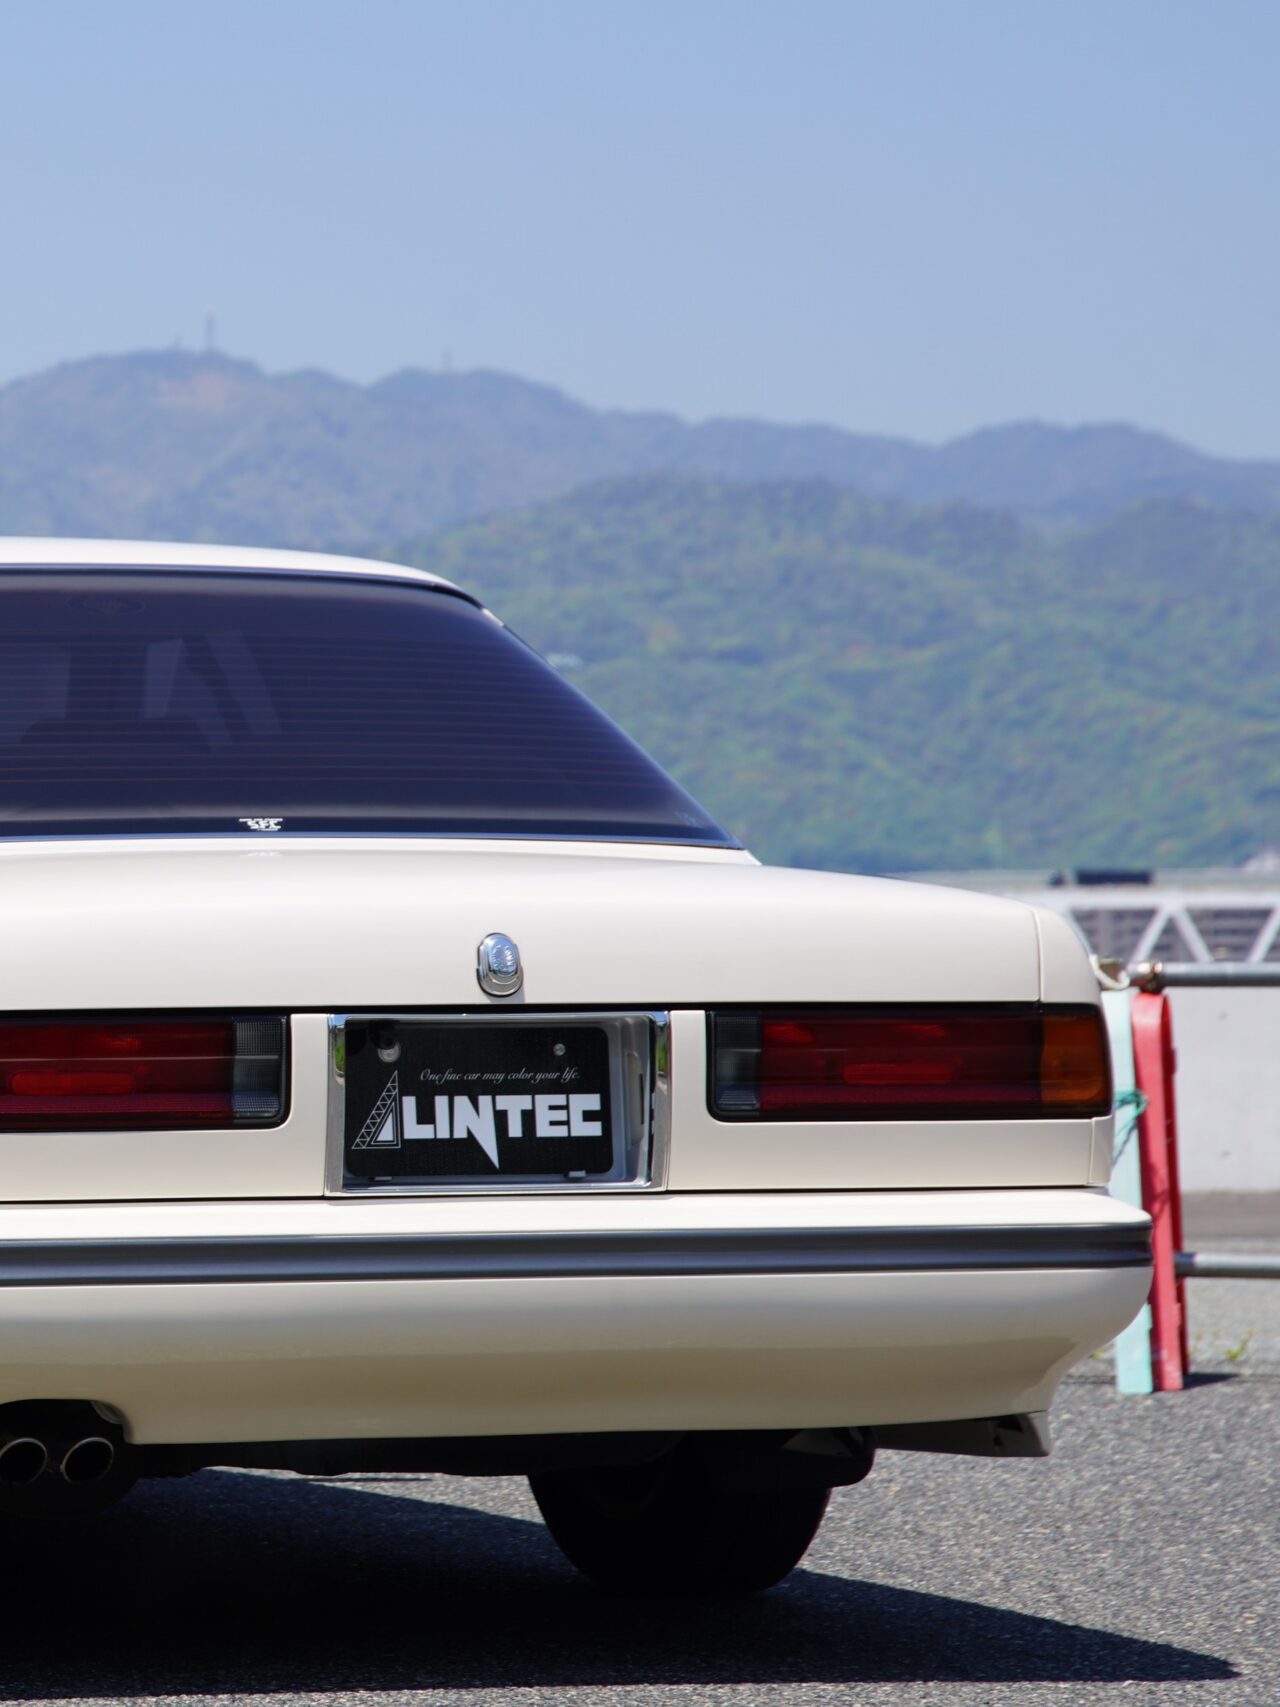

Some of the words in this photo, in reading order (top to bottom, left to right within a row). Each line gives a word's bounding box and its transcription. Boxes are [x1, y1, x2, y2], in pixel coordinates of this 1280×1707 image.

[420, 1068, 441, 1081] One
[436, 1068, 461, 1084] fine
[482, 1073, 505, 1084] may
[508, 1067, 533, 1080] color
[531, 1072, 560, 1084] your
